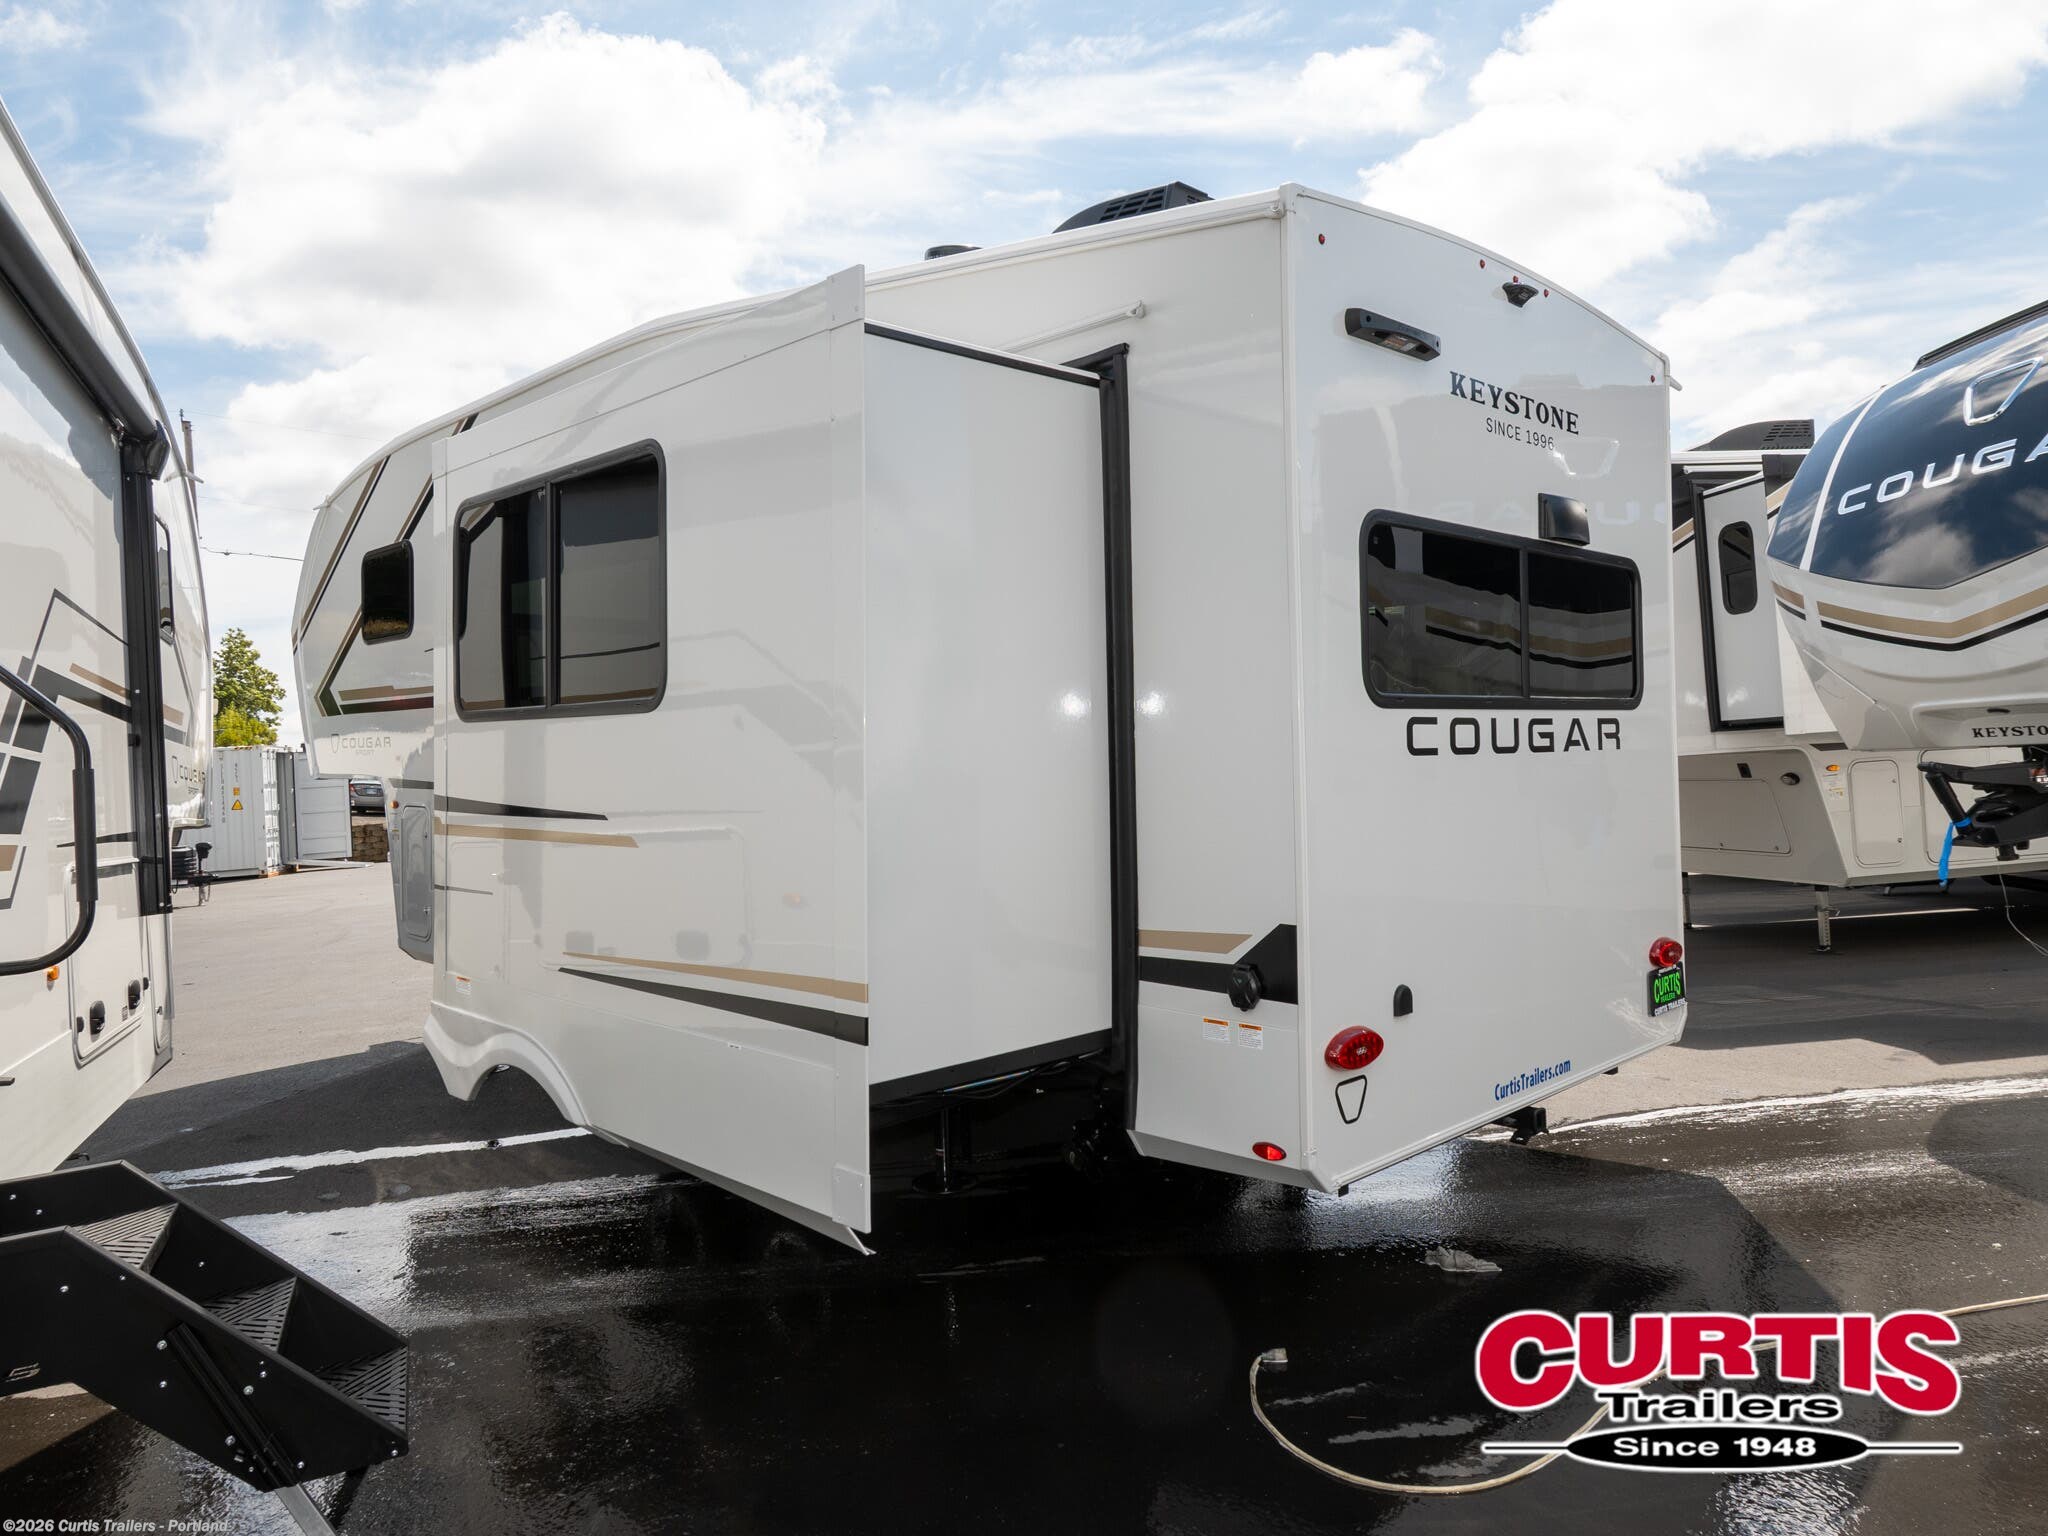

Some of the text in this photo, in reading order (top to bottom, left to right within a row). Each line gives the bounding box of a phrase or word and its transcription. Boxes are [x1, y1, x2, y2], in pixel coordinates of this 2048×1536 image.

[1450, 371, 1579, 435] KEYSTONE
[1486, 417, 1554, 450] SINCE 1996
[342, 736, 391, 749] COUGAR
[1407, 716, 1621, 756] COUGAR
[1972, 725, 2048, 738] KEYSTO
[1654, 972, 1681, 1003] CURTIS
[1494, 1059, 1571, 1101] CurtisTrailers.com
